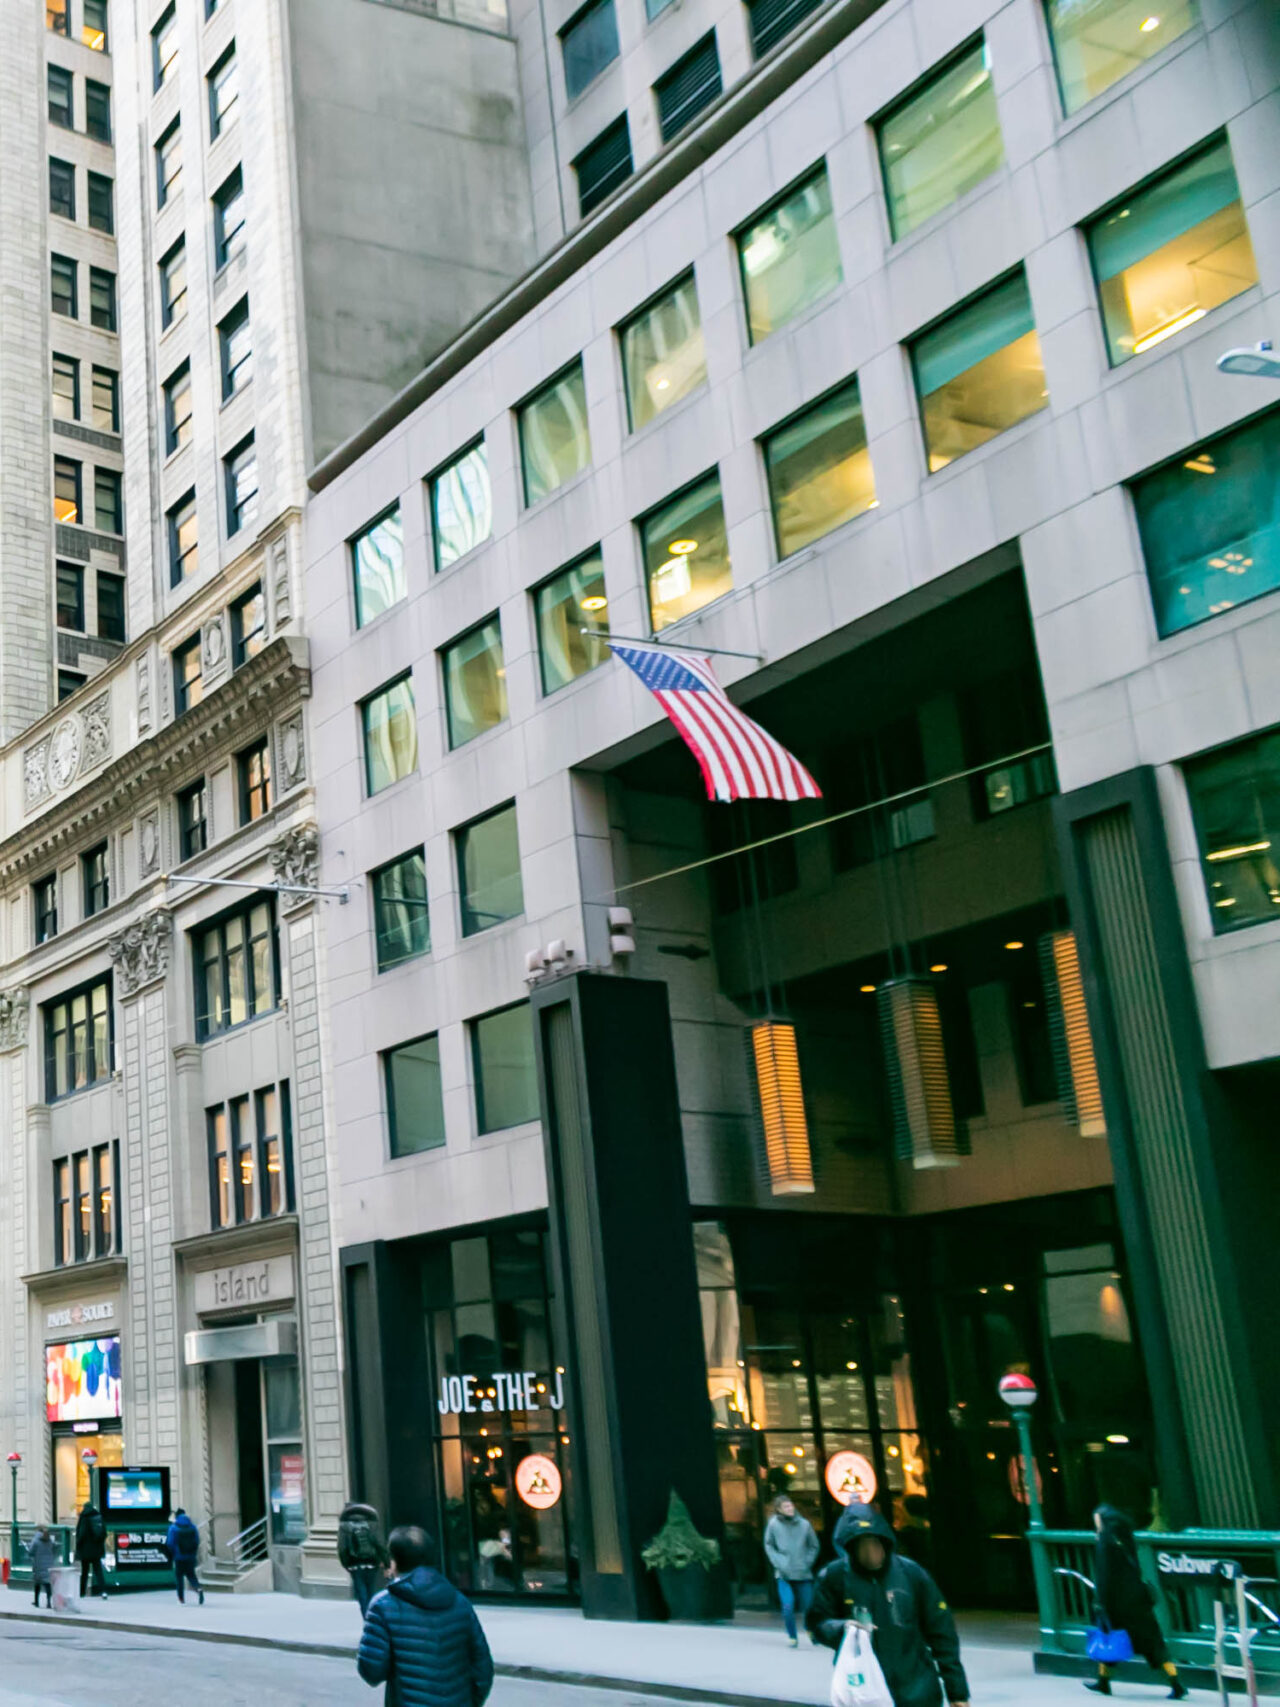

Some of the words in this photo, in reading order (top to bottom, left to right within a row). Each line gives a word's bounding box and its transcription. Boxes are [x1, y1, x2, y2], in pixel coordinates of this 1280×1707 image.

[214, 1263, 270, 1304] island
[438, 1374, 477, 1415] JOE
[481, 1399, 494, 1412] &
[491, 1372, 539, 1411] THE
[128, 1533, 142, 1543] No
[144, 1533, 167, 1544] Entry
[1157, 1552, 1235, 1580] Subwy
